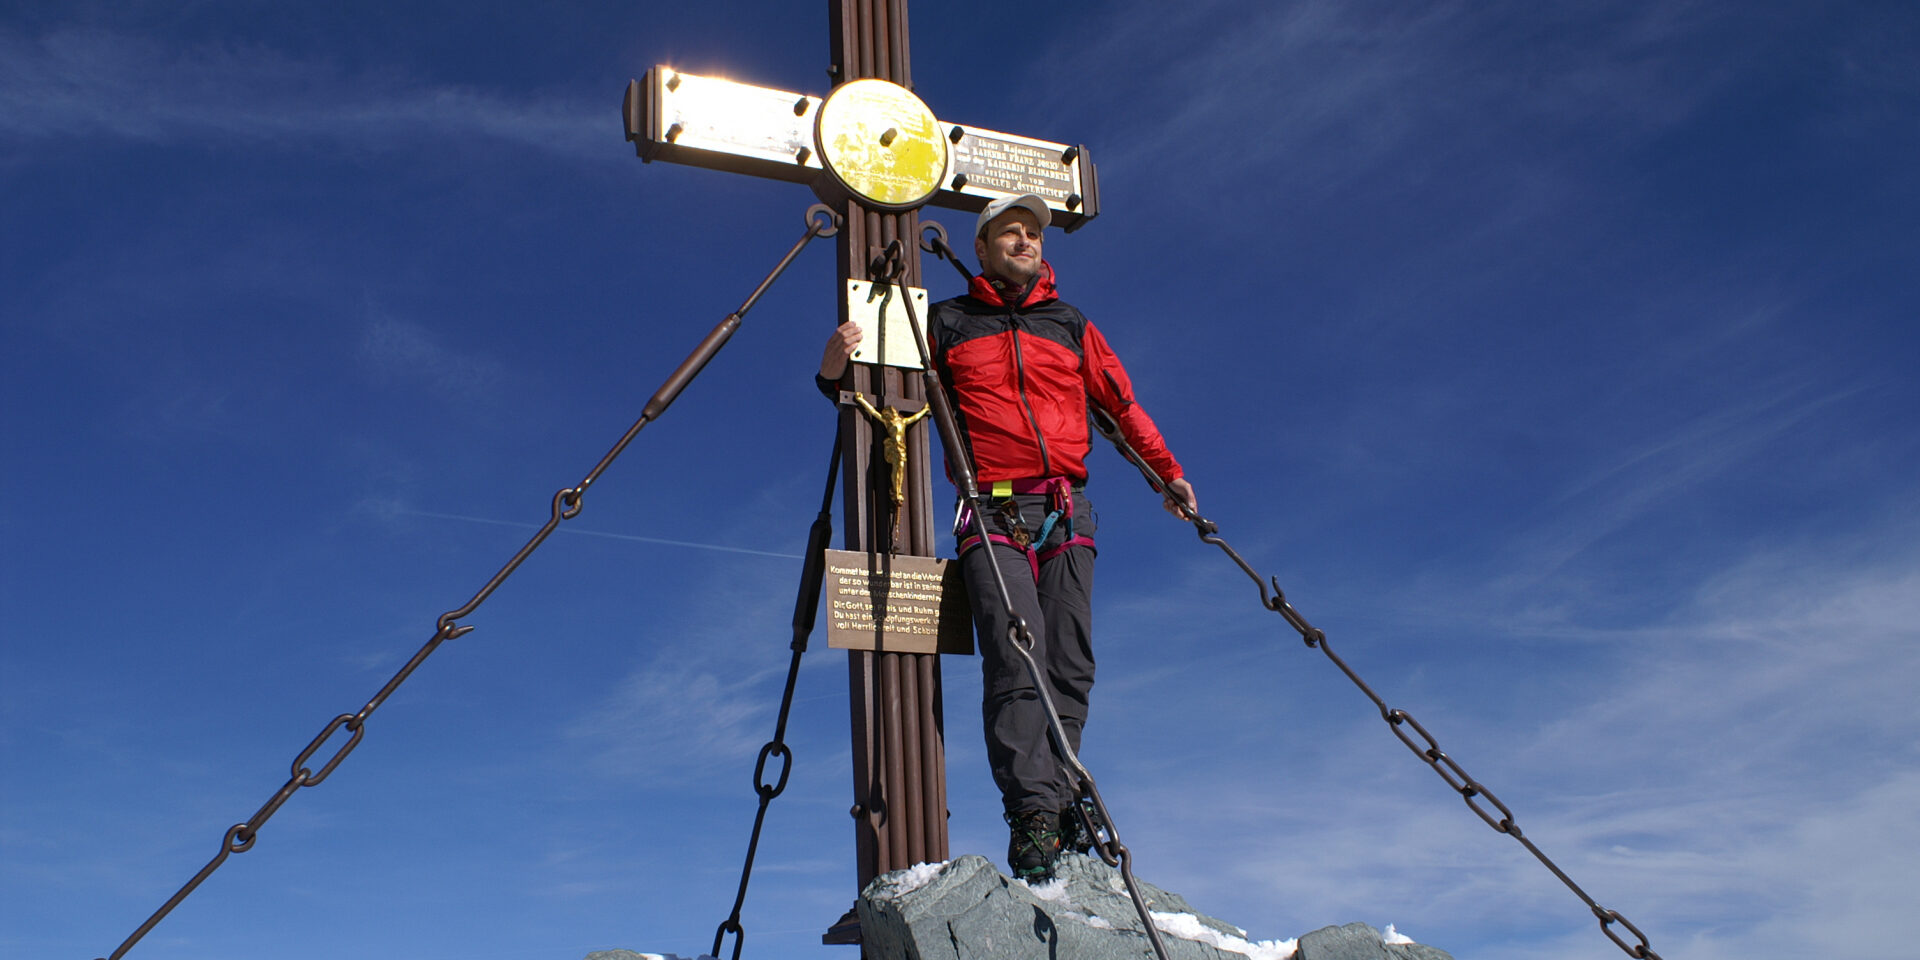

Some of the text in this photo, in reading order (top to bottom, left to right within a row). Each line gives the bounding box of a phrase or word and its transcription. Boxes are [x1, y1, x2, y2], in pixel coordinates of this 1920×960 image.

[1009, 153, 1034, 166] FRANZ
[1028, 166, 1070, 182] ELISABETH
[1029, 177, 1045, 186] vom
[830, 565, 858, 576] Kommet
[838, 576, 852, 584] der
[904, 580, 913, 590] ist
[914, 582, 921, 590] in
[838, 588, 858, 596] unter
[834, 610, 844, 618] Du
[898, 606, 912, 614] und
[914, 606, 934, 615] Ruhm
[834, 621, 850, 630] voll
